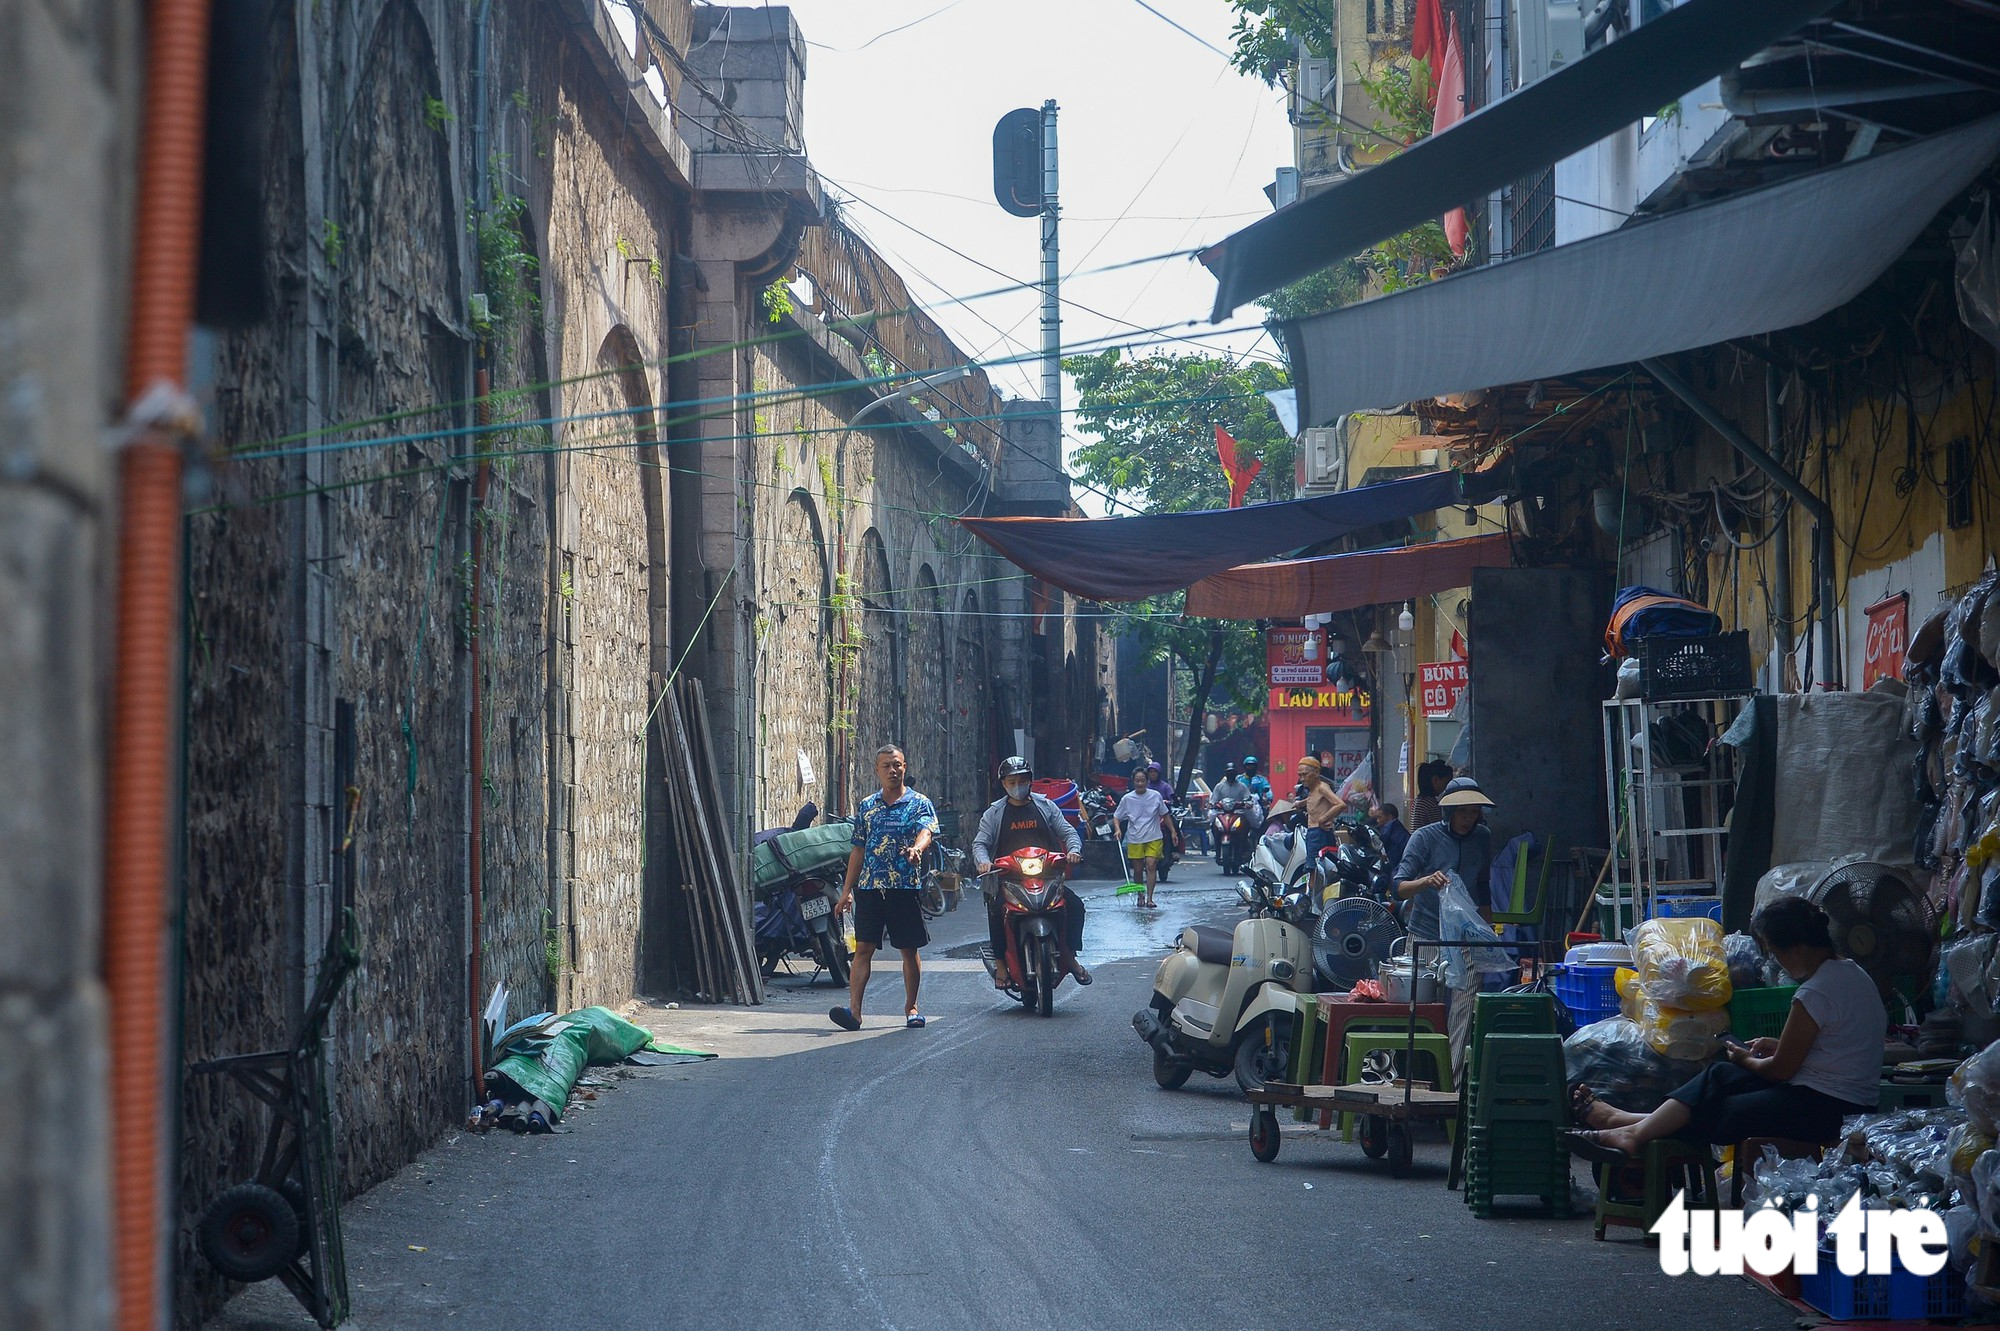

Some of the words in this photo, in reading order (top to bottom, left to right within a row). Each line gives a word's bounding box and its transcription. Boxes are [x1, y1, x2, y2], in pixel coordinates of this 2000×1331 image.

[1423, 664, 1455, 682] BÚN
[1424, 684, 1447, 707] CÔ
[1451, 686, 1465, 703] T
[1011, 820, 1037, 830] AMIRI
